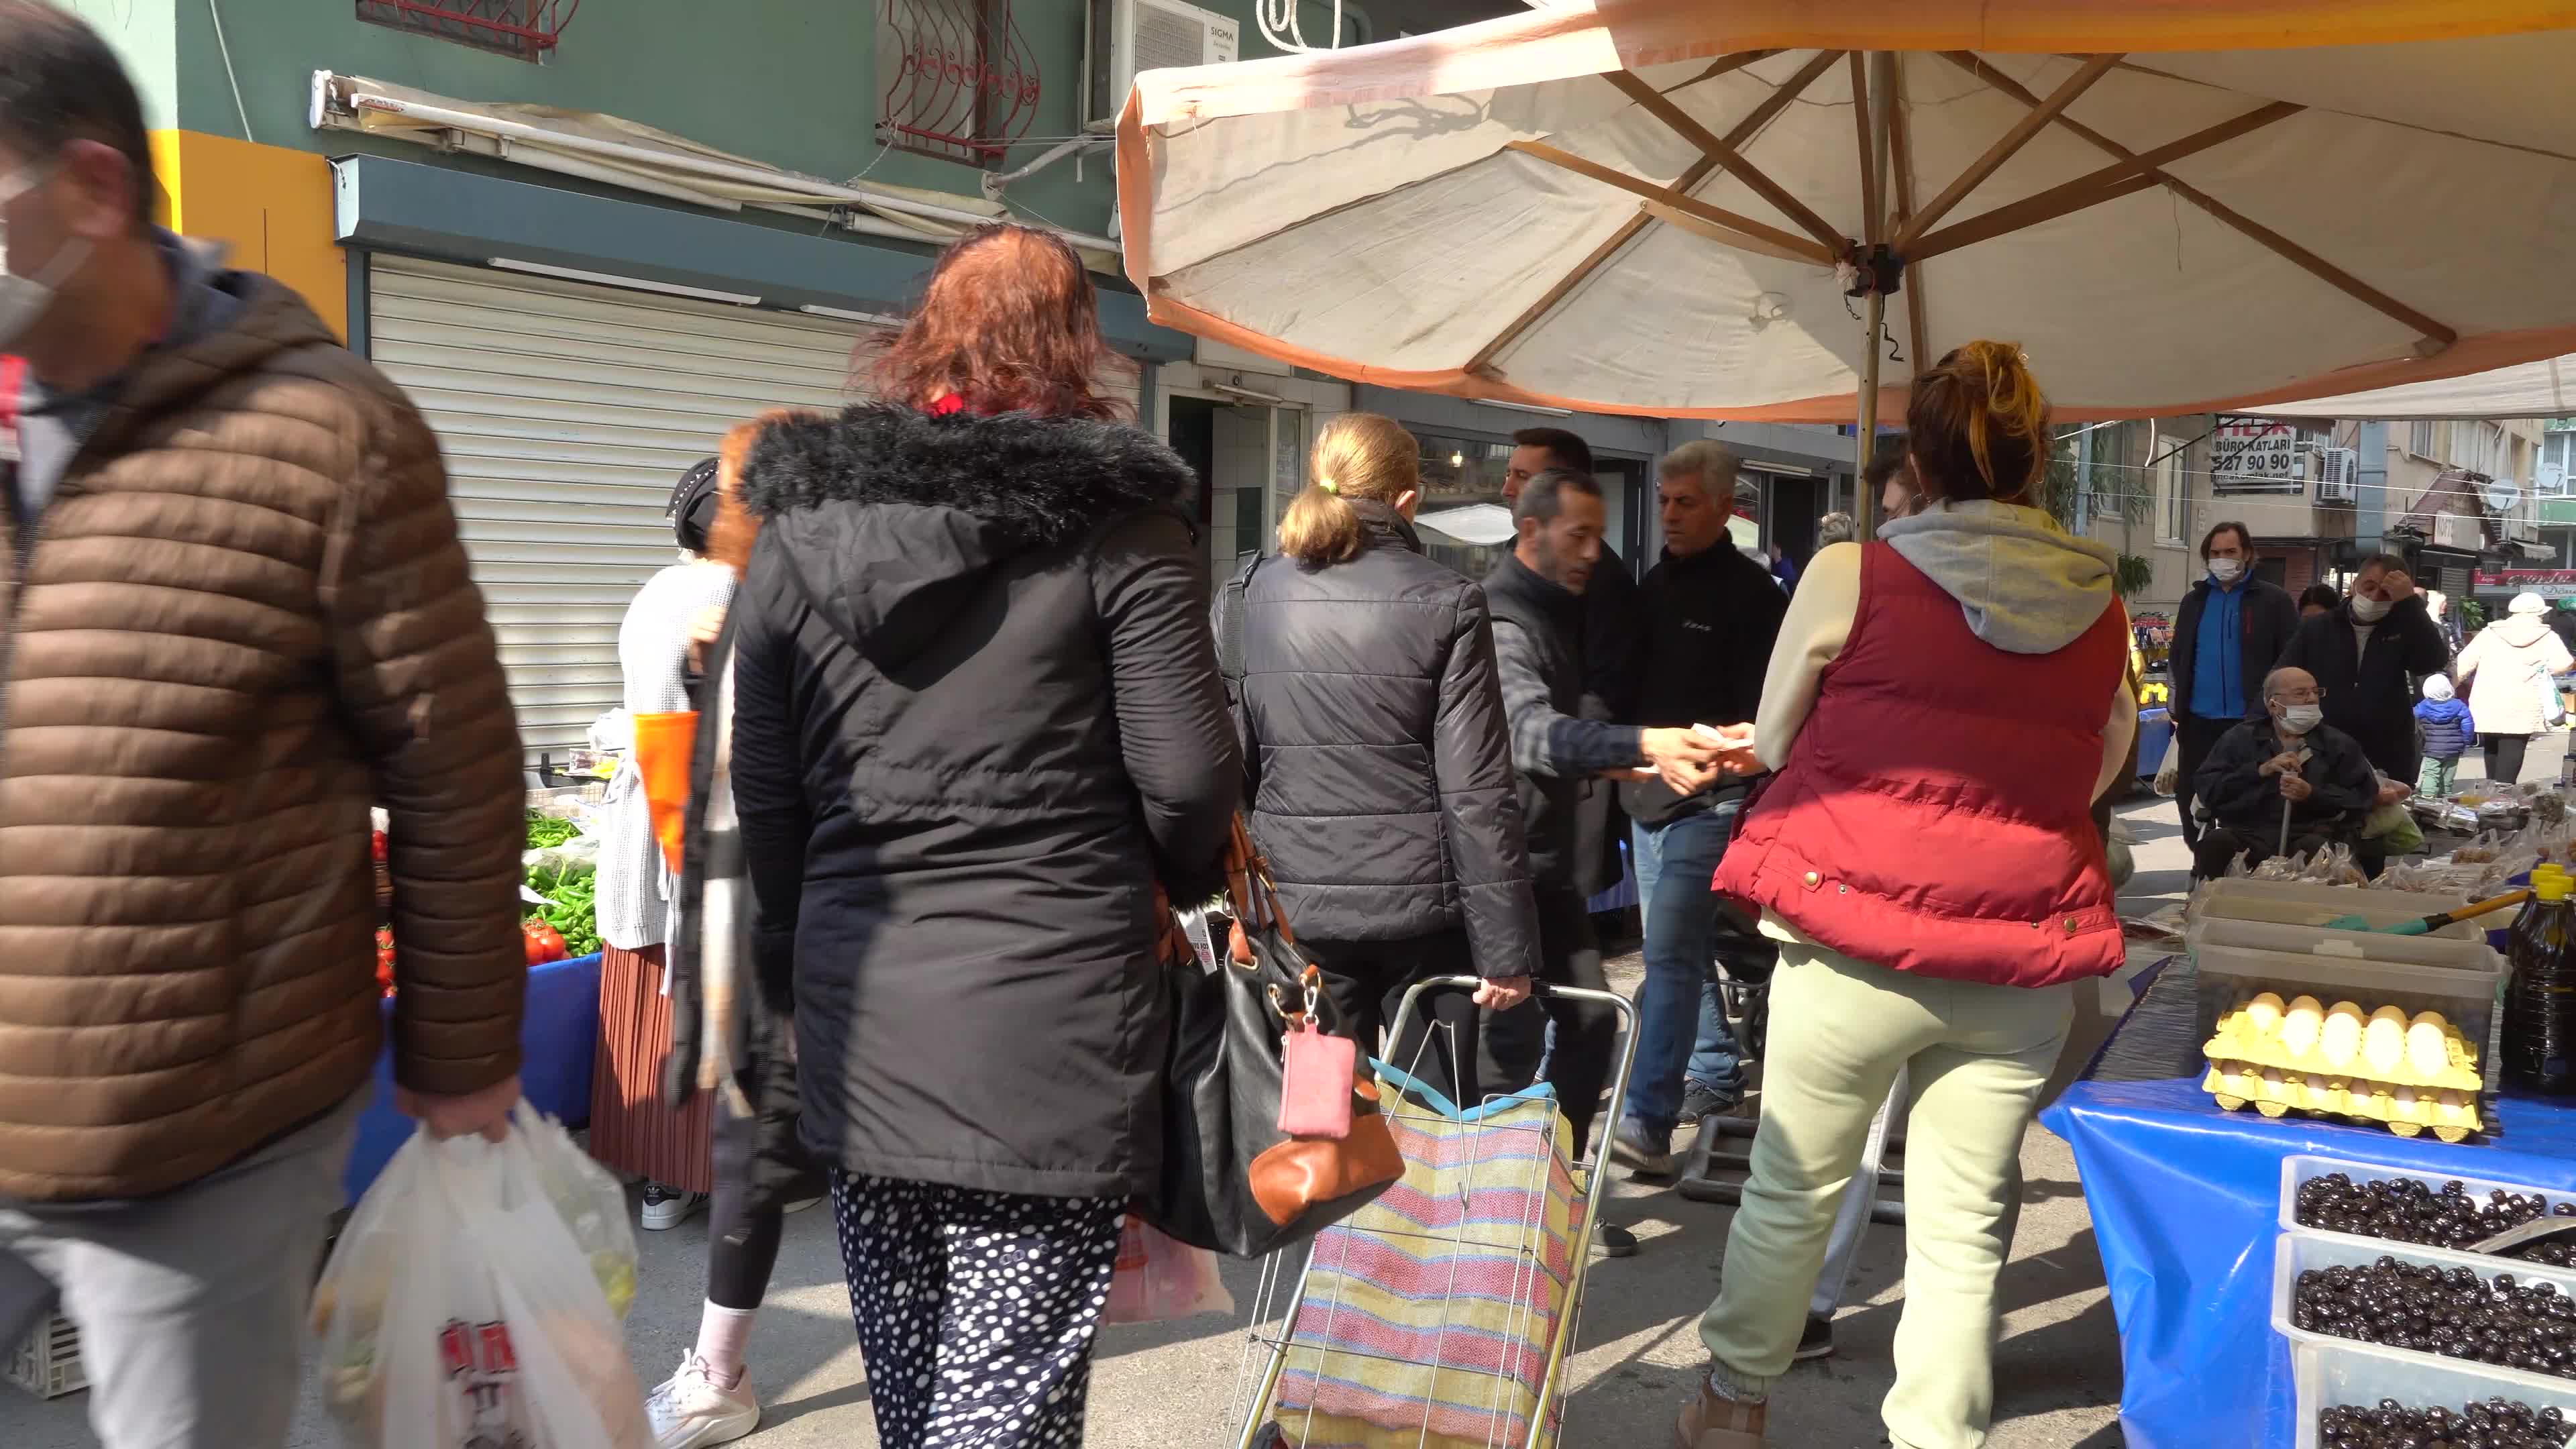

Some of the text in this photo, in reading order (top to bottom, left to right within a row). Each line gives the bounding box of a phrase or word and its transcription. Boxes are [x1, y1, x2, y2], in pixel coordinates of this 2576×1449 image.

[1211, 27, 1234, 41] SIGMA
[2216, 438, 2290, 451] BÜRO KATLARI
[2247, 454, 2265, 470] 90
[2270, 453, 2290, 469] 90
